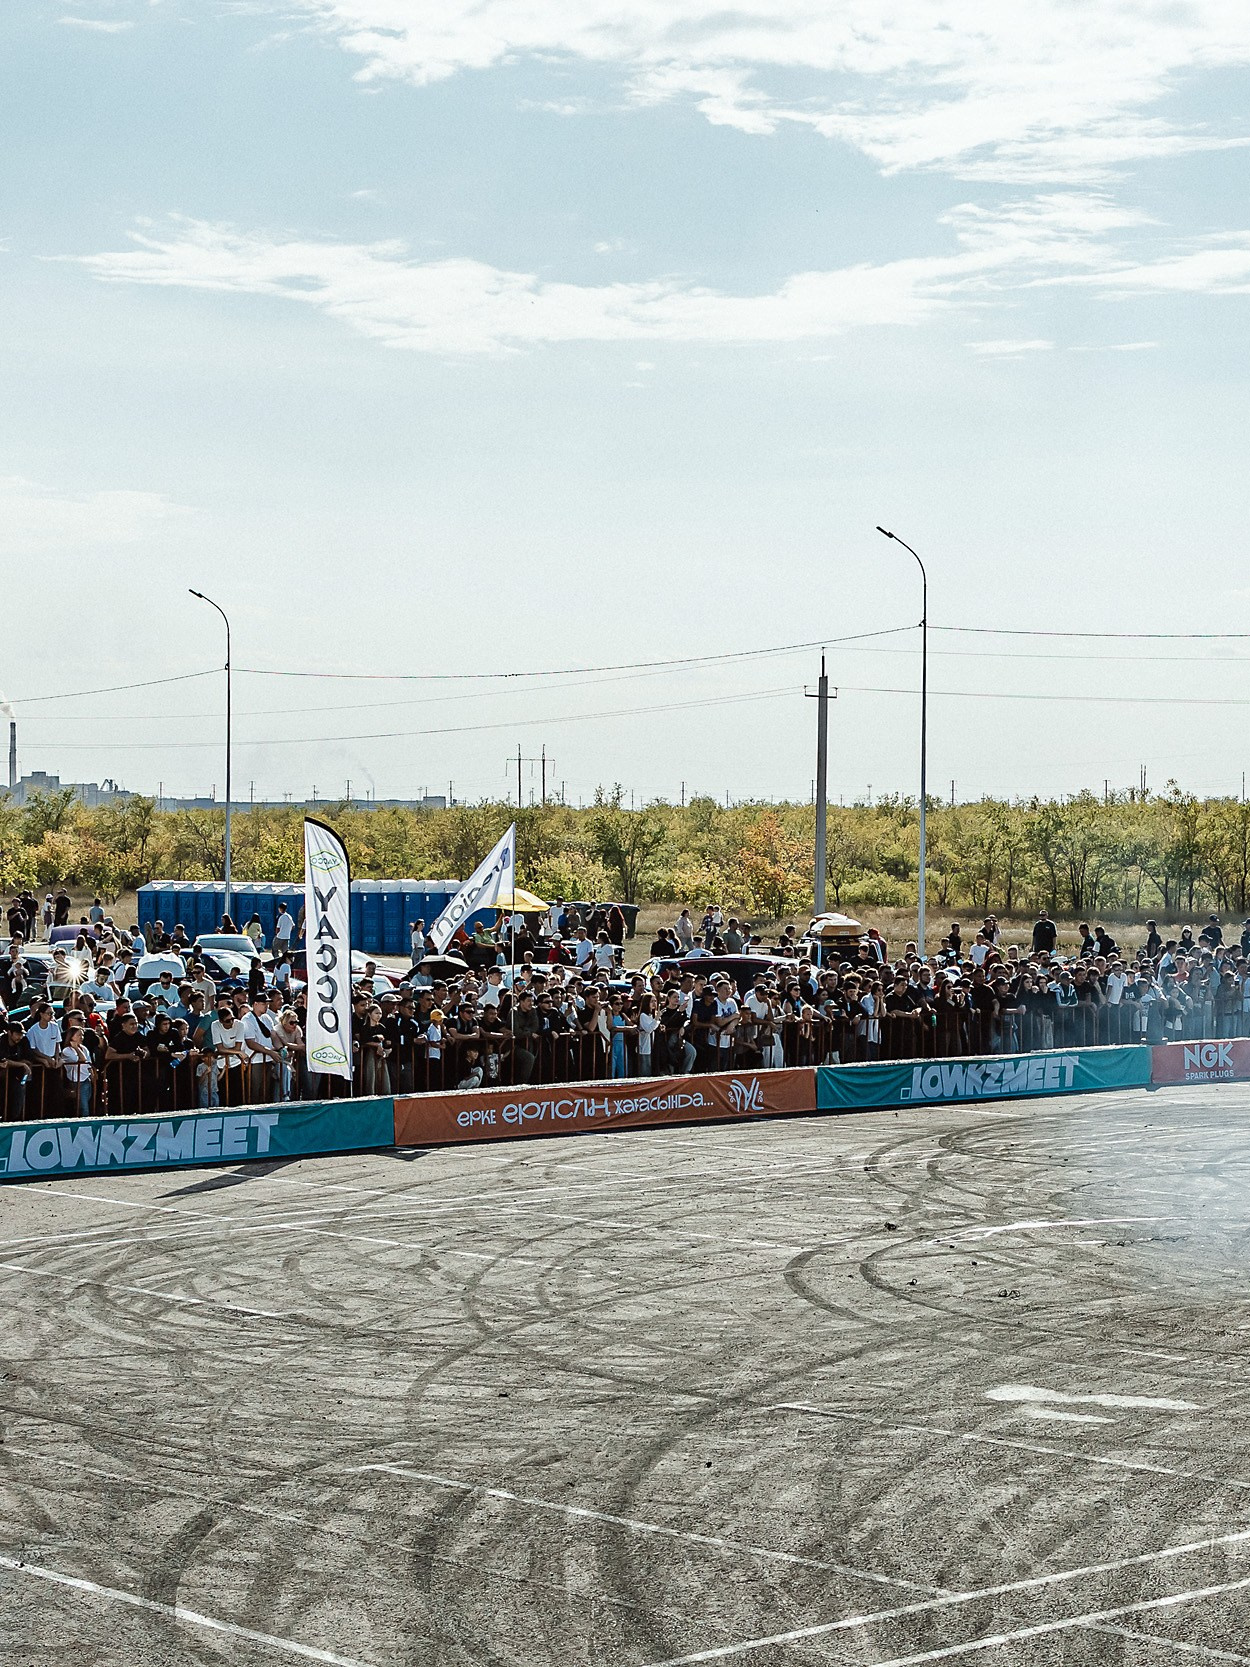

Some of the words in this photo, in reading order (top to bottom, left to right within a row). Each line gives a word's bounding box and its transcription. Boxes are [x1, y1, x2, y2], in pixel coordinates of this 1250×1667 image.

[1184, 1041, 1234, 1069] NGK
[911, 1056, 1080, 1099] LOWKZMEET
[1185, 1072, 1209, 1080] SPARK
[1210, 1070, 1234, 1079] PLUGS
[8, 1113, 279, 1172] LOWKZMEET
